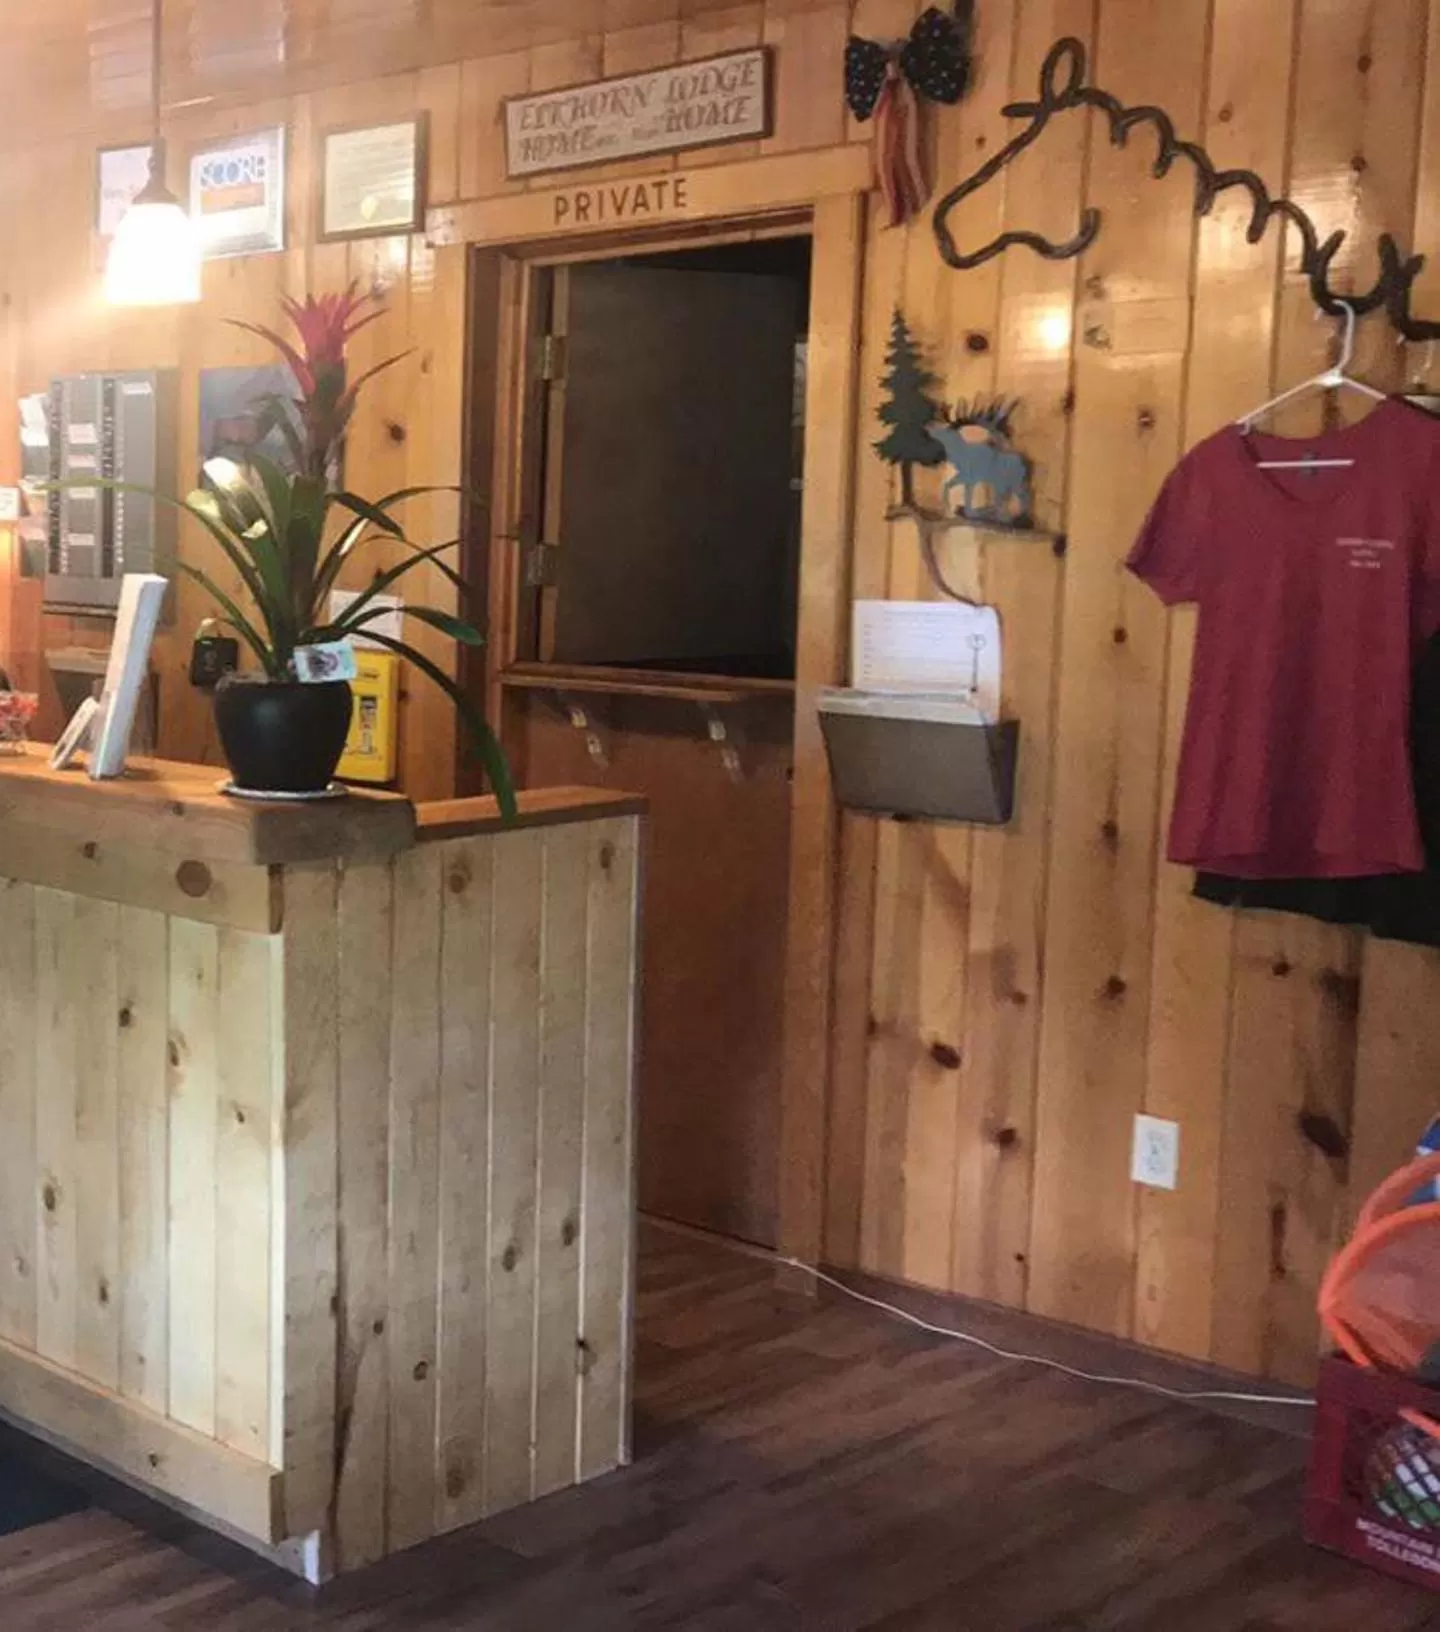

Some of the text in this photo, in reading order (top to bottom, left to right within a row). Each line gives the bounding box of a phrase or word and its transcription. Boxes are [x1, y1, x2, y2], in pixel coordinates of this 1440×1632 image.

[520, 56, 760, 131] ELKHORN LODGE
[519, 124, 598, 163] HOME
[660, 95, 753, 134] HOME
[553, 177, 688, 226] PRIVATE
